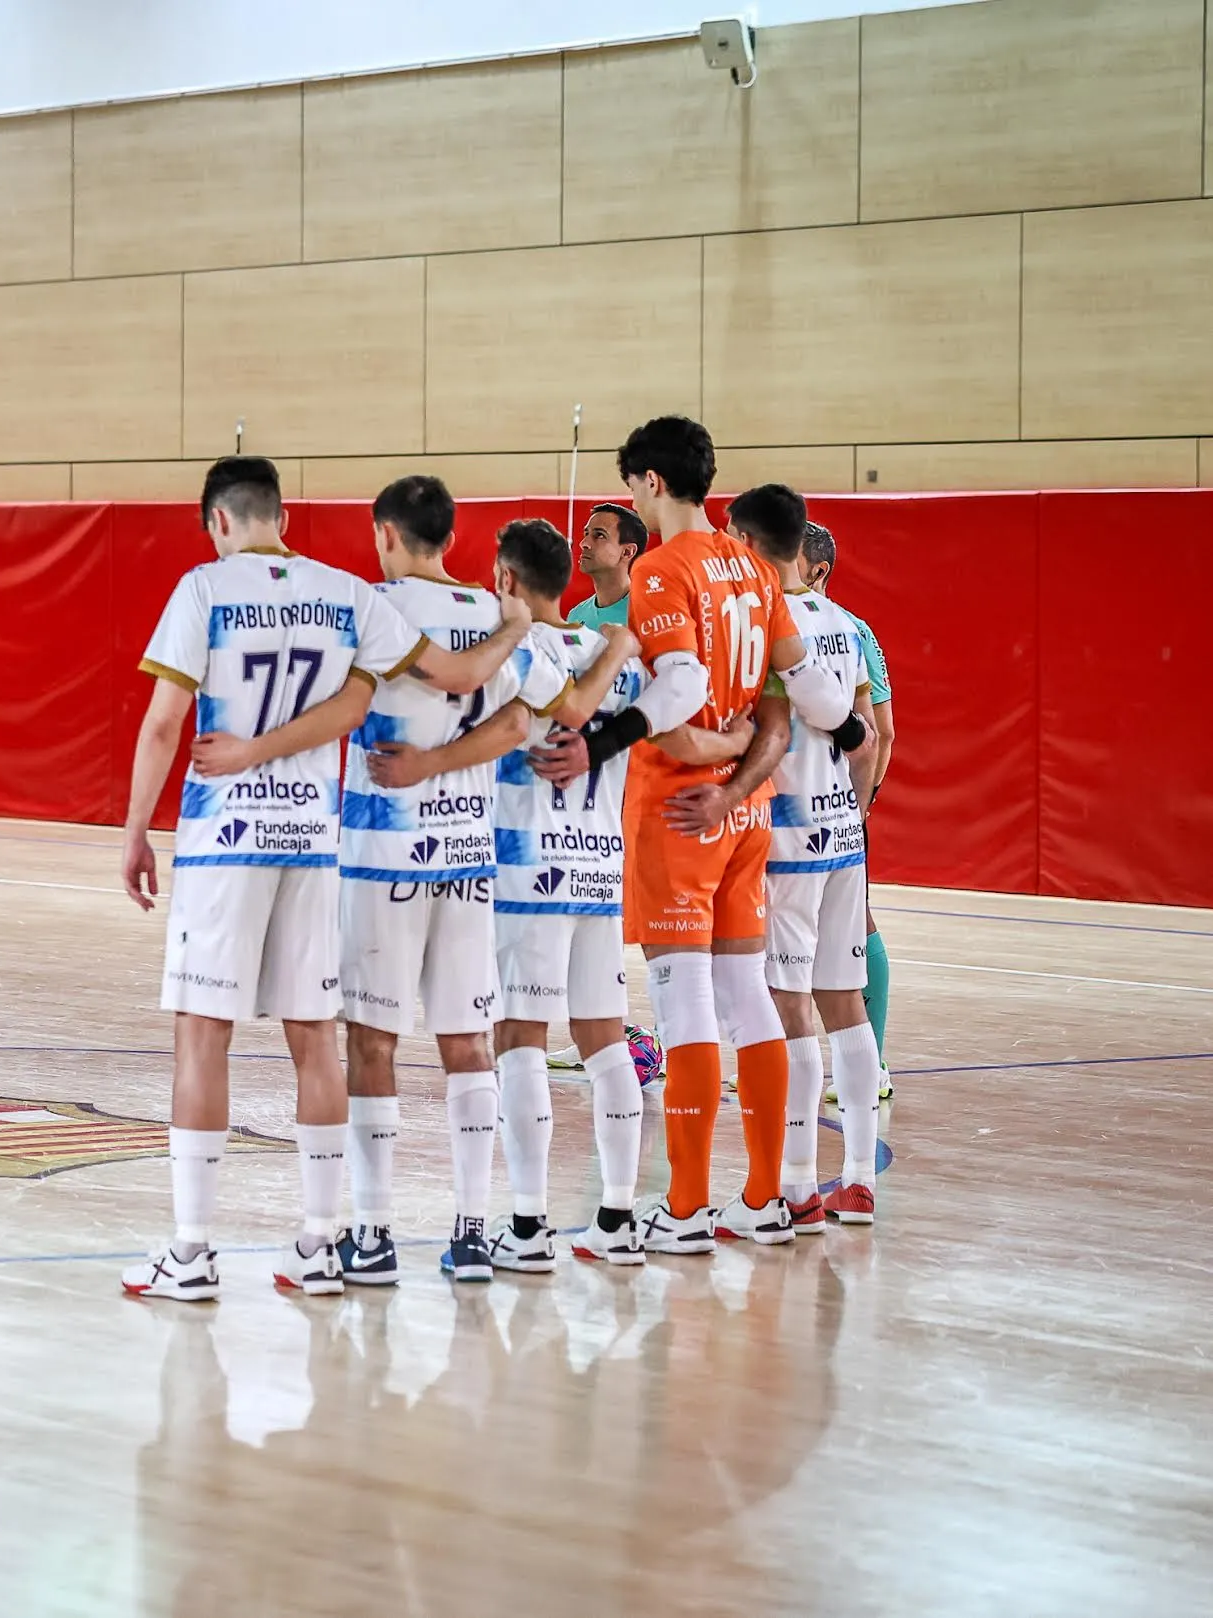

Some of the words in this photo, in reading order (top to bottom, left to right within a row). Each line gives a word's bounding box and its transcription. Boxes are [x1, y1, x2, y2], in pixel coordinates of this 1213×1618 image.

[222, 605, 276, 631] PABLO
[721, 591, 765, 689] 16
[242, 647, 325, 738] 77
[227, 773, 320, 806] málaga
[255, 820, 327, 836] Fundación
[256, 836, 312, 856] Unicaja
[541, 825, 623, 858] málaga
[445, 848, 492, 866] Unicaja
[570, 869, 622, 886] Fundació
[570, 884, 614, 904] Unicaja
[666, 1107, 702, 1115] KELME
[466, 1218, 484, 1238] FS
